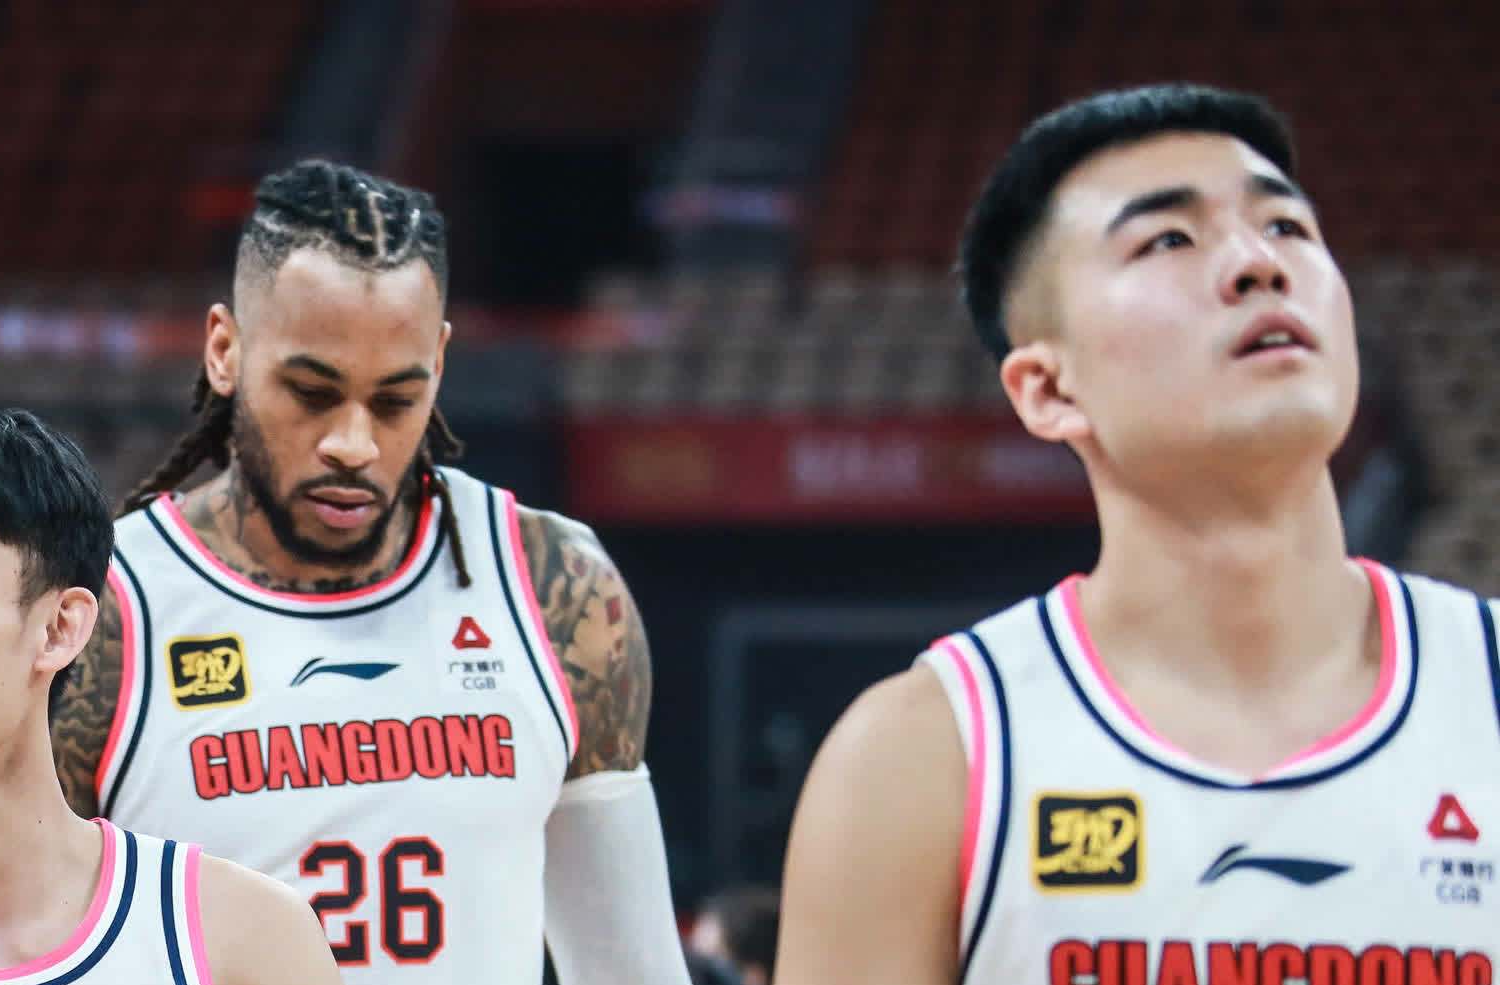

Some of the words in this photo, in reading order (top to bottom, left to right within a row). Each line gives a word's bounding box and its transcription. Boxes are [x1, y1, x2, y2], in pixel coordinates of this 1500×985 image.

[461, 676, 497, 690] CGB
[190, 714, 515, 800] GUANGDONG
[299, 836, 445, 967] 26
